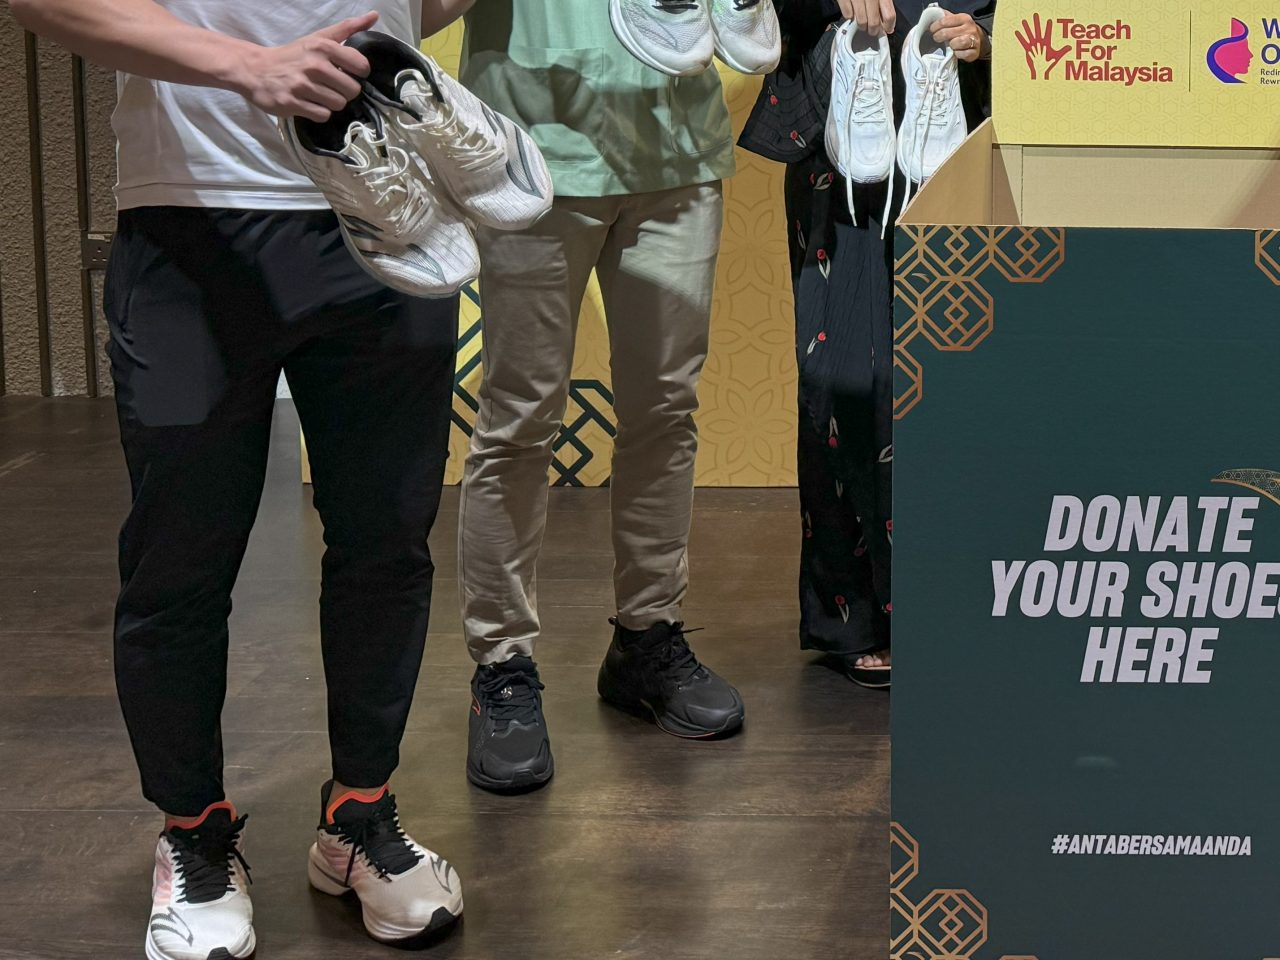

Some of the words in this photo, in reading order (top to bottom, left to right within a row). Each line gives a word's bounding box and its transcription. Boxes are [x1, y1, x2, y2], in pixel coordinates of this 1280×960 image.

[1056, 18, 1131, 40] Teach
[1075, 40, 1118, 61] For
[1065, 60, 1174, 87] Malaysia
[1043, 494, 1261, 553] DONATE
[991, 559, 1131, 618] YOUR
[1079, 626, 1220, 684] HERE
[1050, 833, 1252, 857] #ANTABERSAMAANDA
